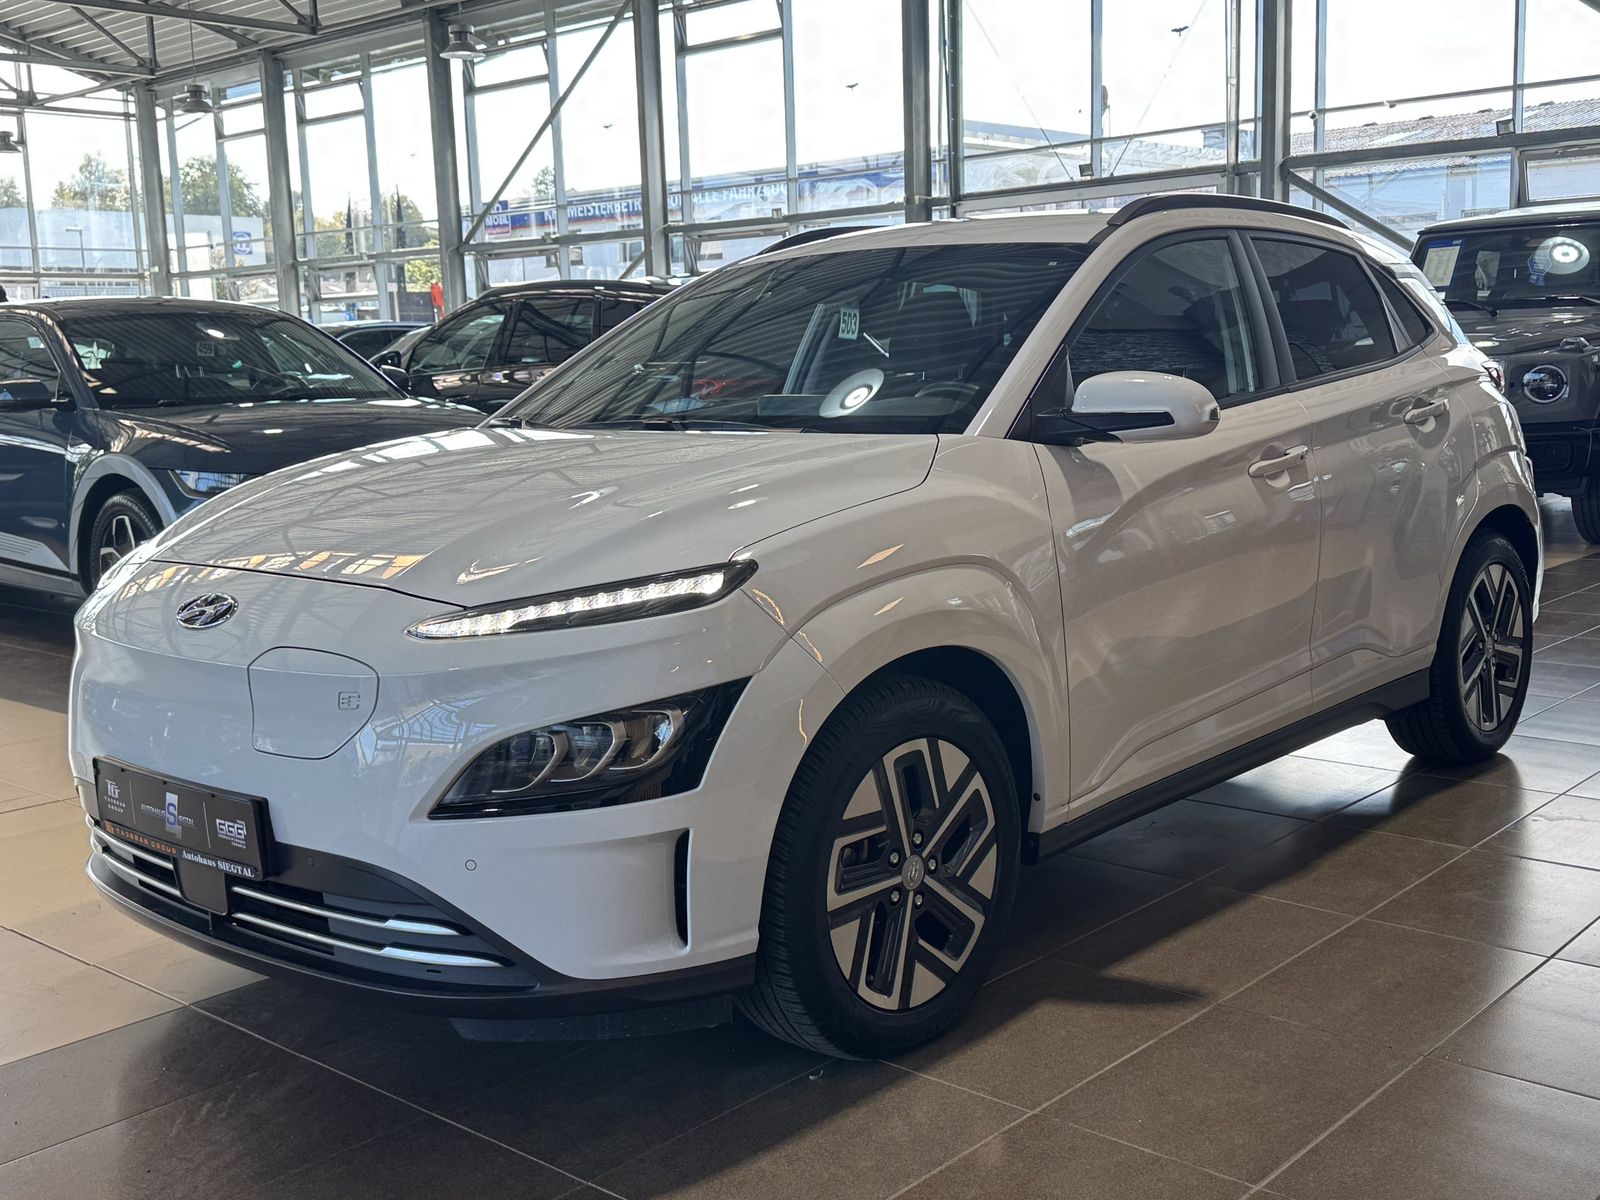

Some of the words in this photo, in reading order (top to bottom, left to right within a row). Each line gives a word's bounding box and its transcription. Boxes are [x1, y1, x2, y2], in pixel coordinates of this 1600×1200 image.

[841, 311, 857, 335] 503
[198, 342, 213, 354] 459
[215, 818, 247, 840] GGG
[182, 850, 217, 868] Autohaus
[217, 860, 255, 878] SIEGTAL
